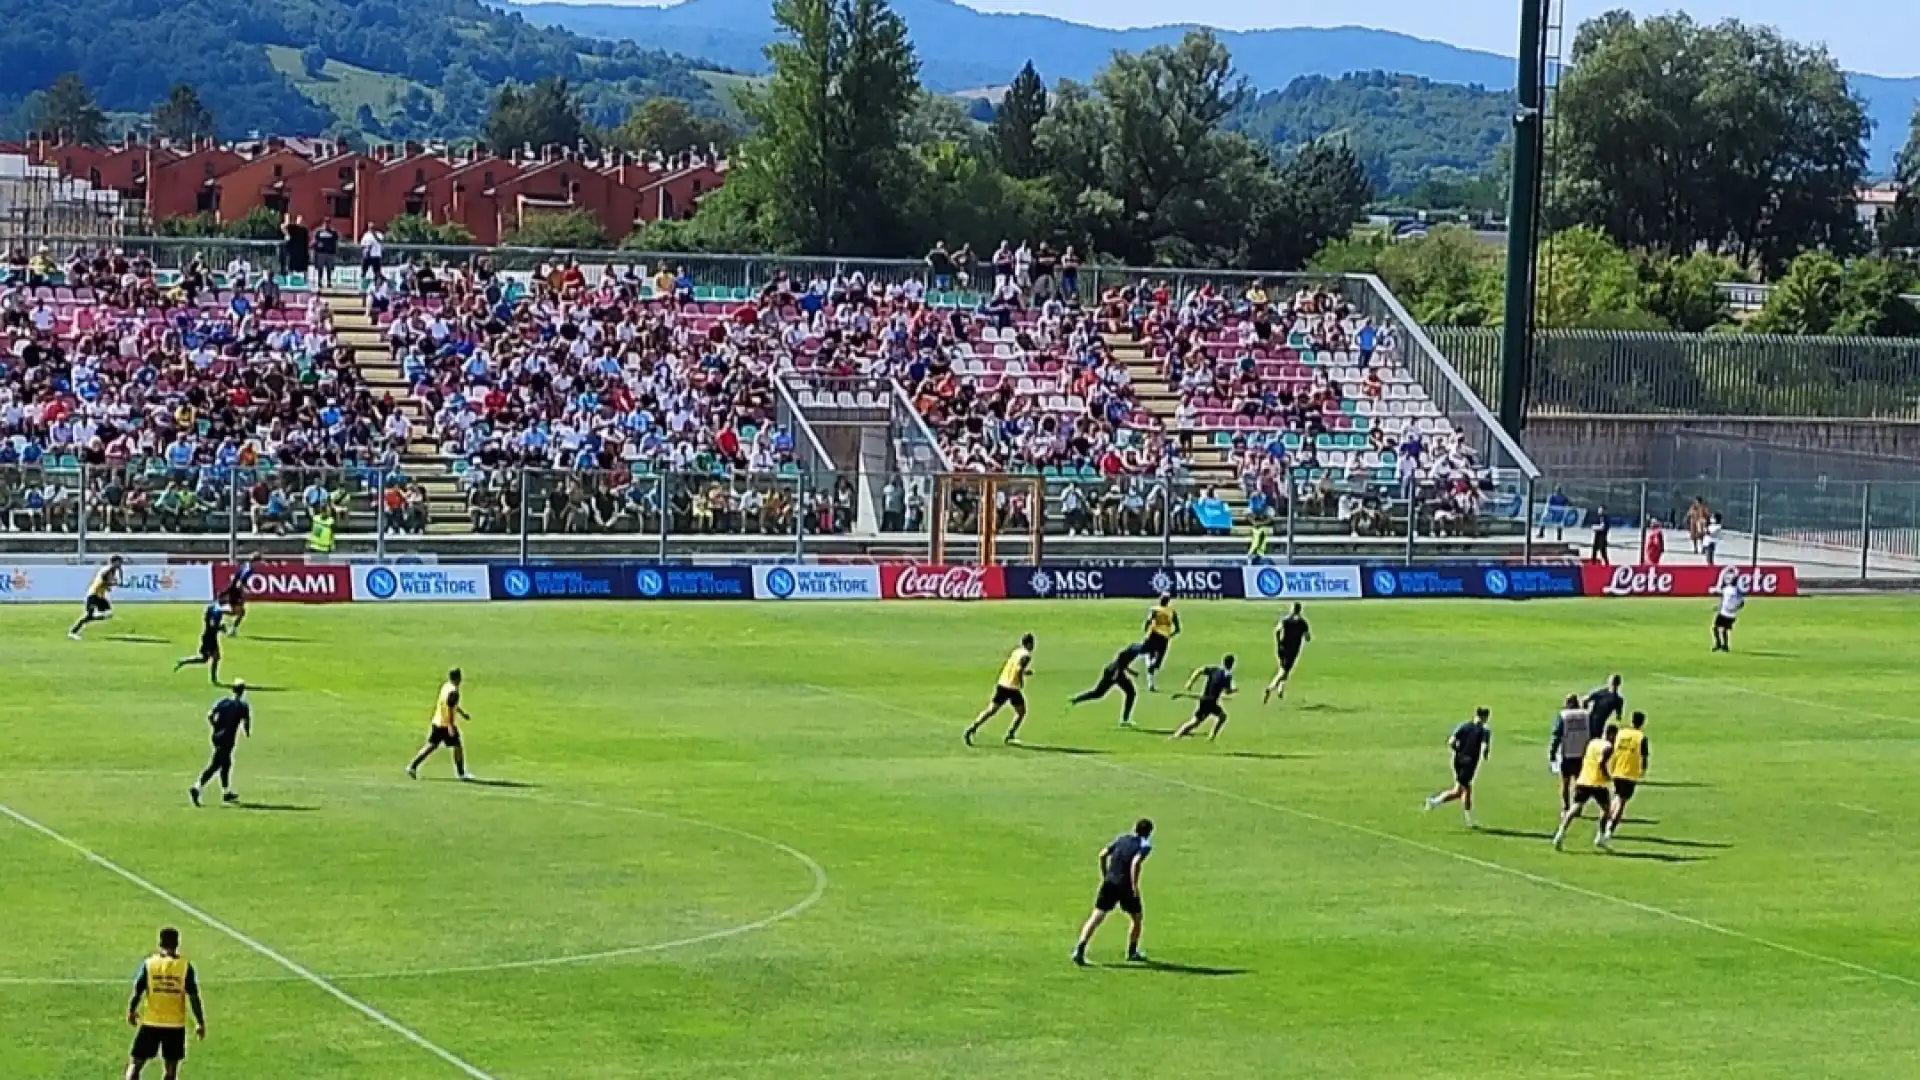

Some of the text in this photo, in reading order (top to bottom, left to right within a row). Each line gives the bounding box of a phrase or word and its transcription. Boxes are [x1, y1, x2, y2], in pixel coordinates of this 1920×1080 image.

[1055, 570, 1104, 591] MSC
[1174, 570, 1223, 591] MSC
[1602, 565, 1673, 595] Lete
